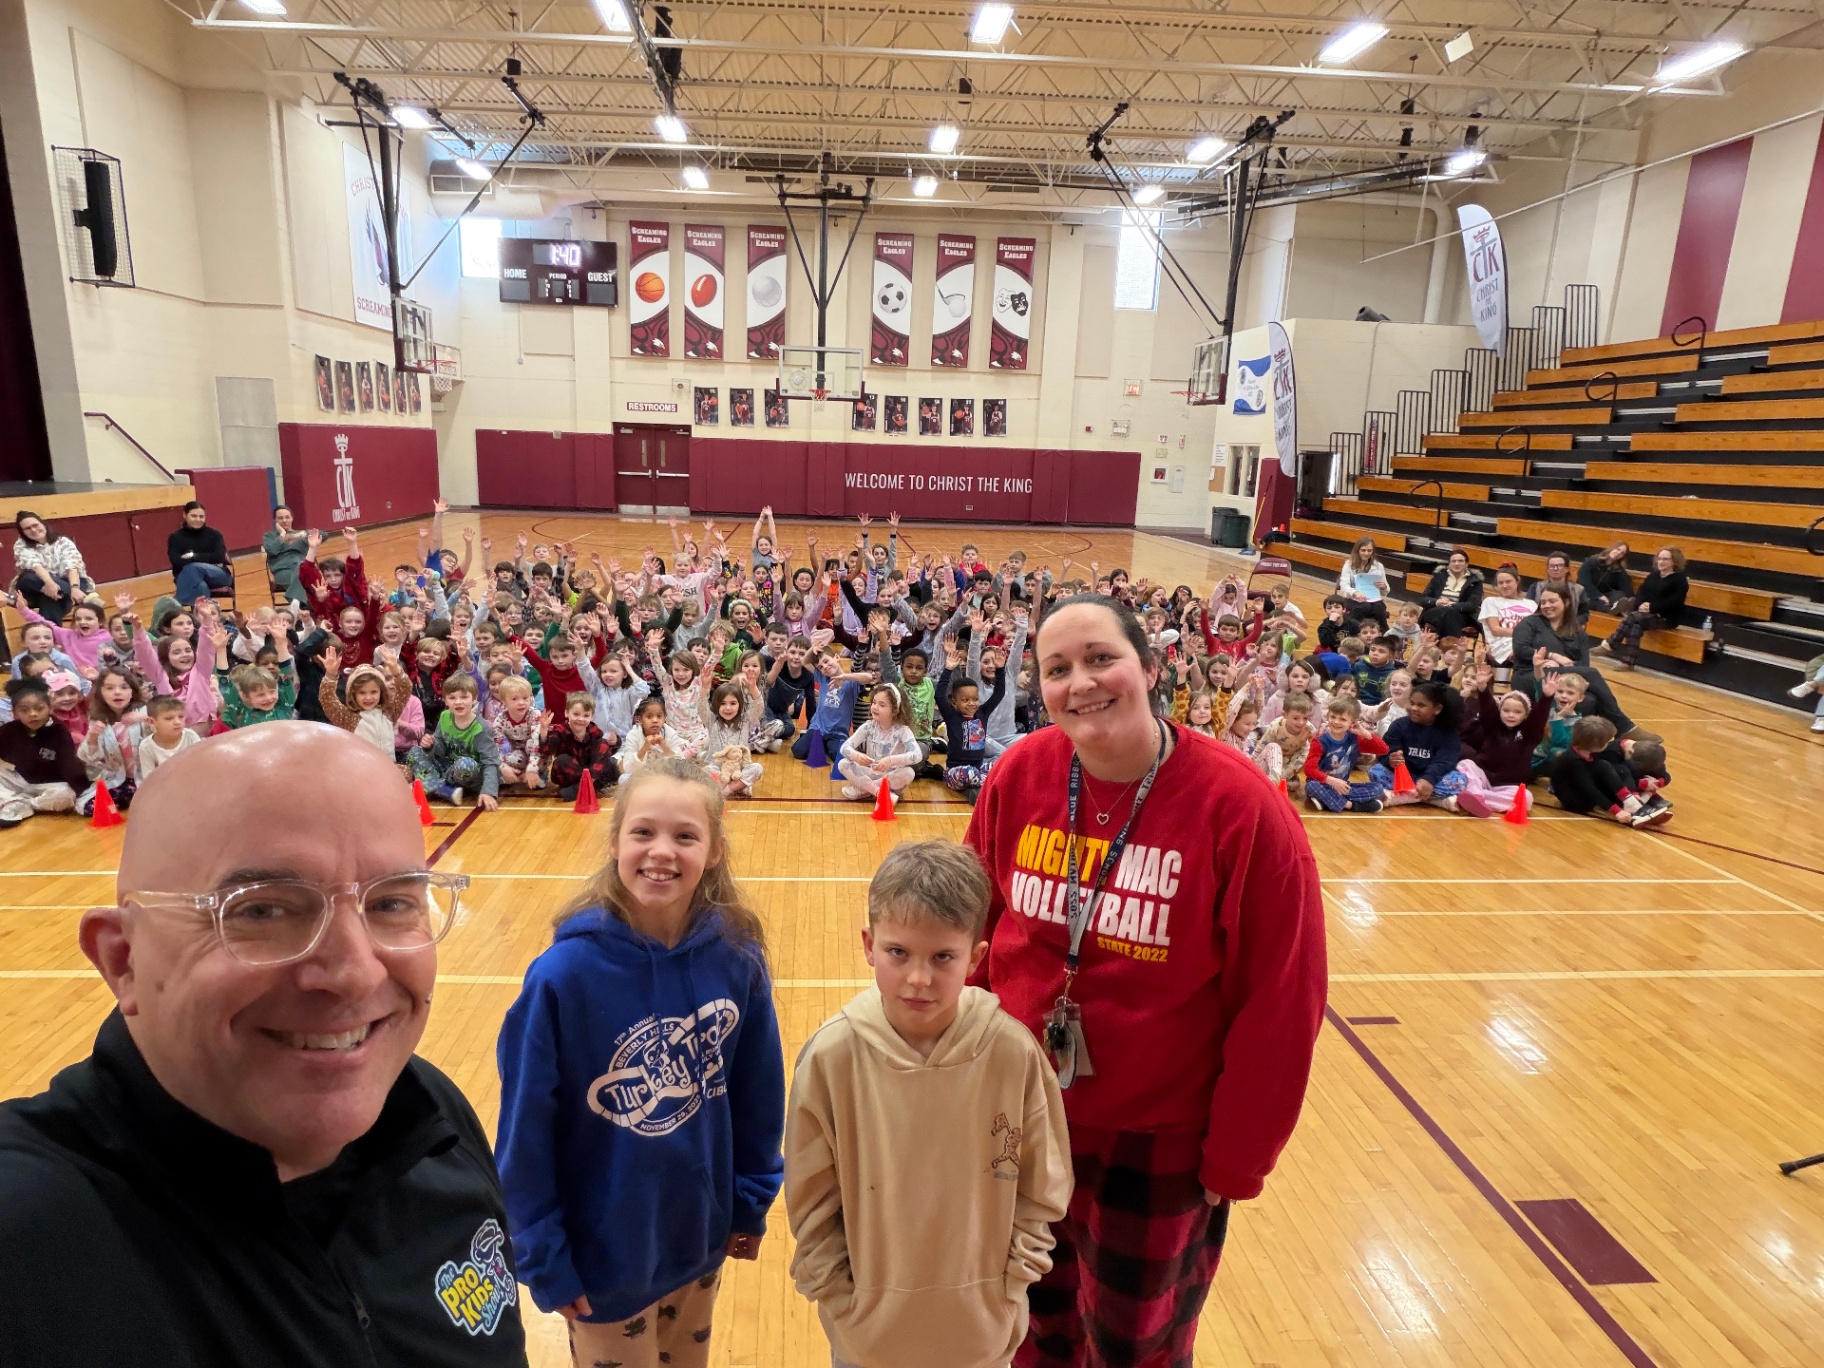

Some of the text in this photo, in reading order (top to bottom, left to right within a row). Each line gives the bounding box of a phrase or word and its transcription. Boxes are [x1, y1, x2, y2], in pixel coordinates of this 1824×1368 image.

[503, 268, 527, 279] HOME
[587, 272, 613, 283] GUEST
[1476, 278, 1498, 302] CHRIST
[356, 296, 393, 319] SCREAMIN
[1480, 302, 1497, 323] KING
[628, 402, 676, 412] RESTROOMS
[845, 472, 1033, 494] WELCOME TO CHRIST THE KING
[1114, 843, 1183, 899] MAC
[1097, 937, 1169, 963] STATE 2022
[628, 1013, 656, 1035] Annual
[615, 1023, 675, 1068] BEVERLY HILS
[604, 1055, 691, 1111] Turkey
[640, 1117, 677, 1131] NOVEMBER
[441, 1267, 456, 1289] The
[441, 1267, 479, 1319] PRO
[460, 1278, 494, 1328] KIDS
